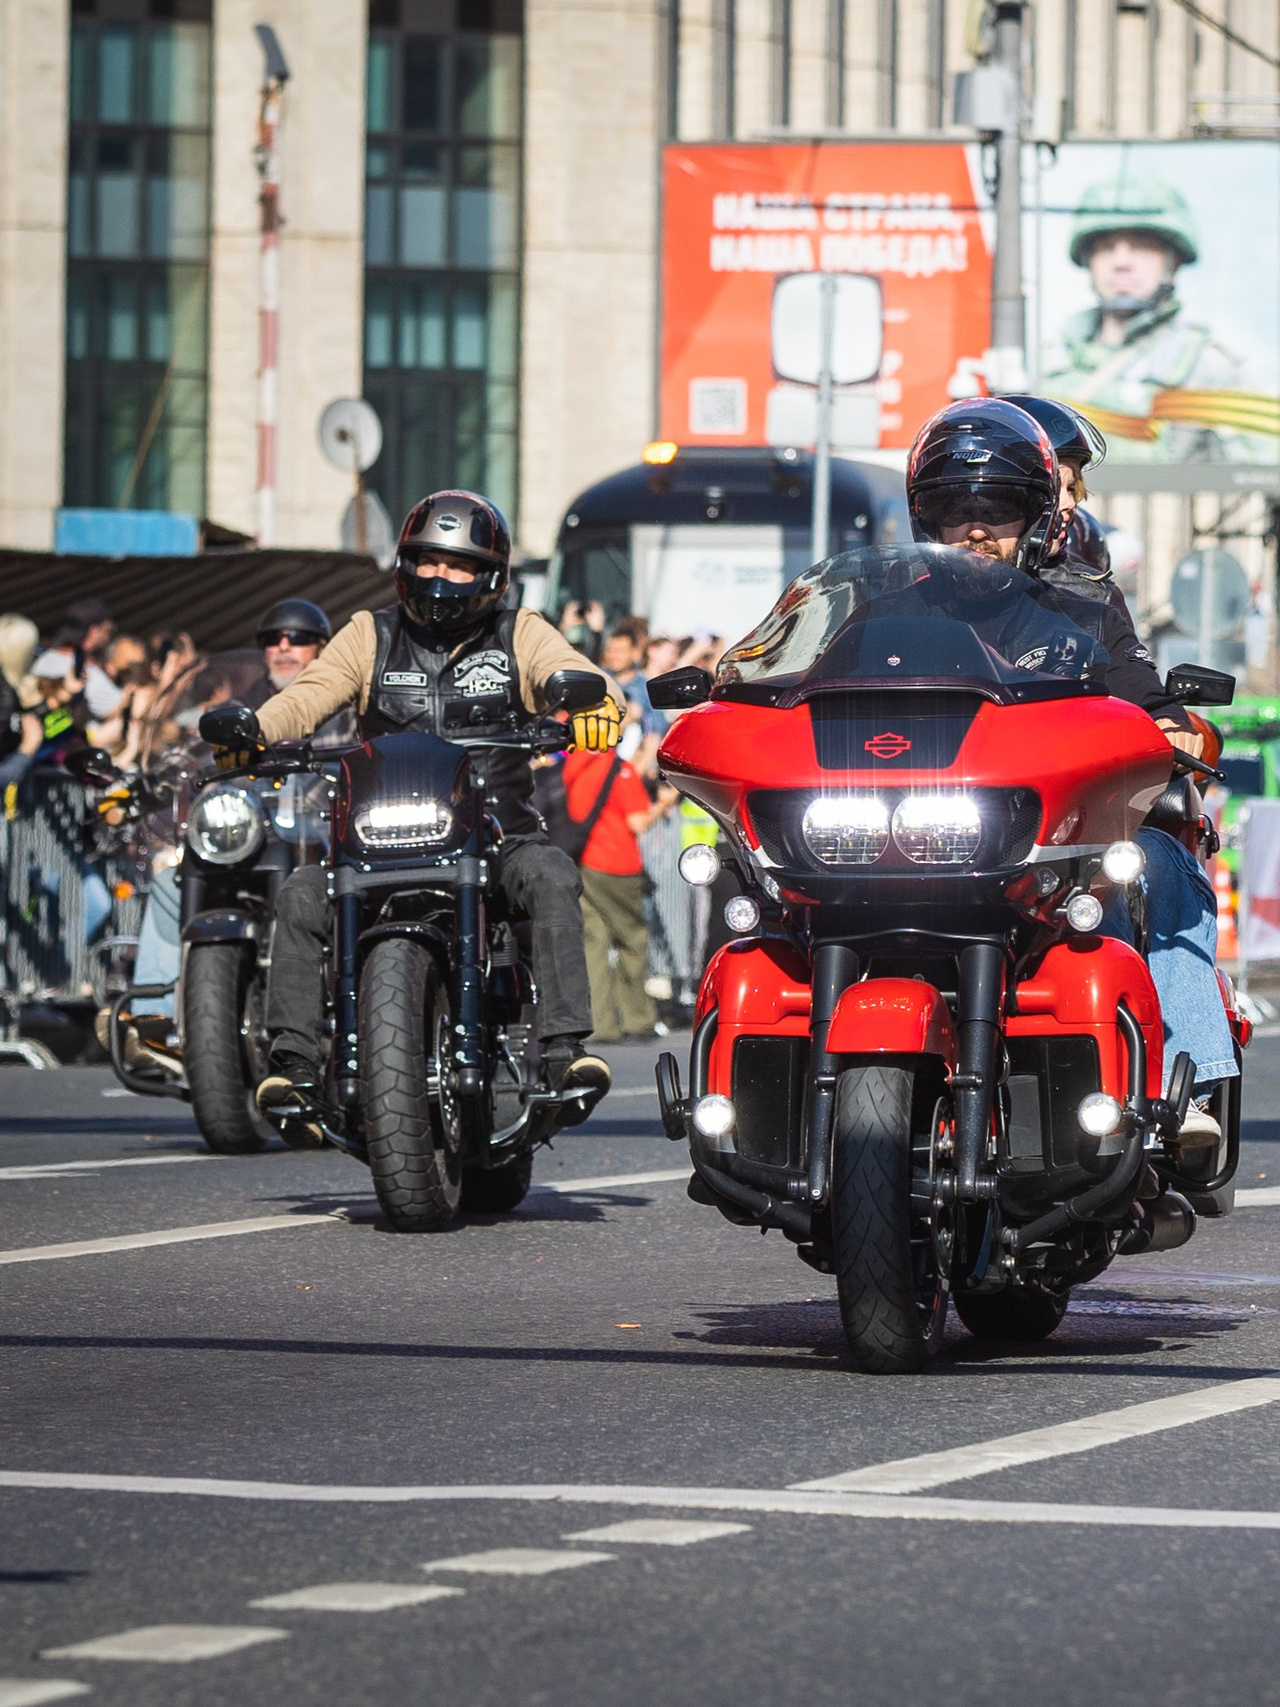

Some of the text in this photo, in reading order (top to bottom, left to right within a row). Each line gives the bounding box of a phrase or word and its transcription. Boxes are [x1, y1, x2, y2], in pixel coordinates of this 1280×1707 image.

[713, 192, 817, 230] НАША
[710, 234, 968, 277] НАША ПОБЕДА!
